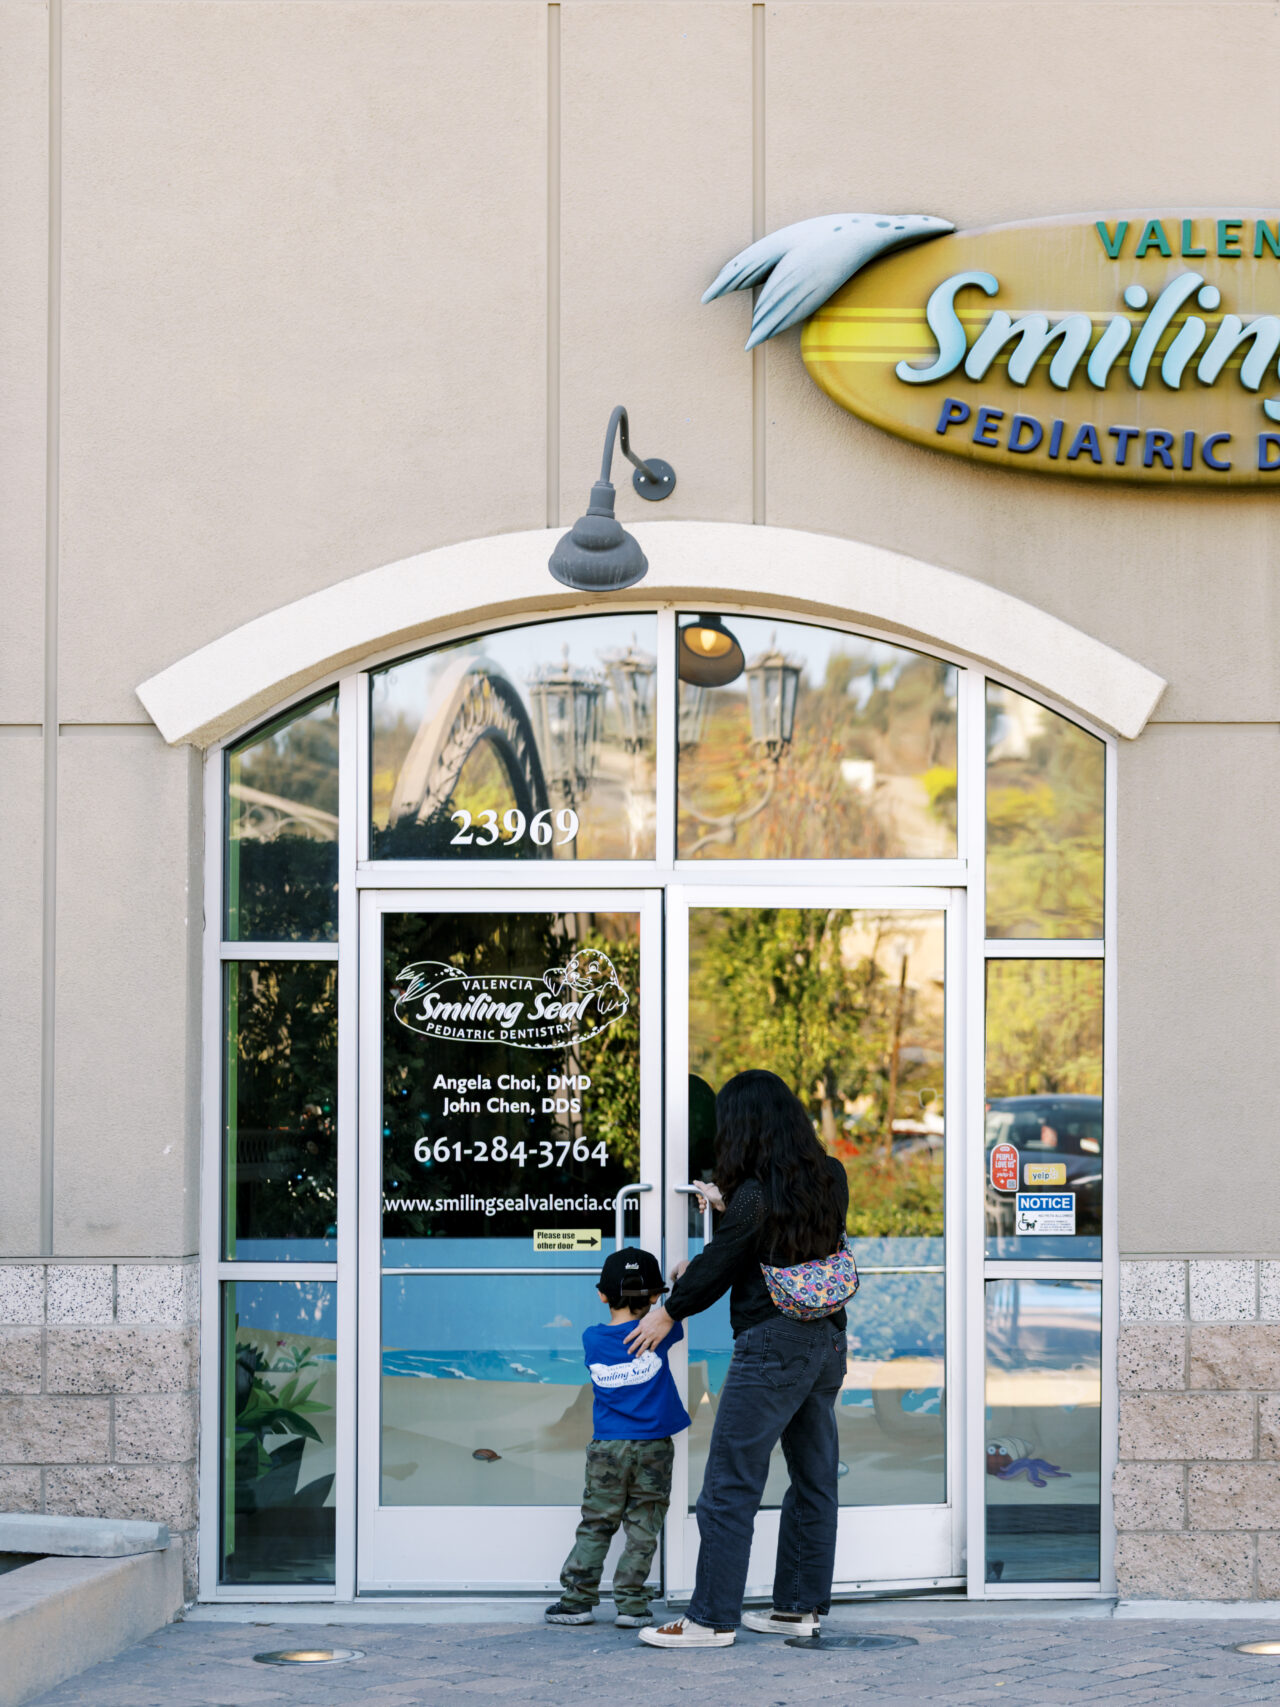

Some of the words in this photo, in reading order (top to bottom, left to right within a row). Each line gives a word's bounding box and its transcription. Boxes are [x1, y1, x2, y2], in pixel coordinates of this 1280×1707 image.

[935, 399, 1233, 472] PEDIATRIC
[450, 808, 579, 846] 23969
[462, 979, 533, 991] VALENCIA
[416, 992, 524, 1028] Smiling
[528, 991, 595, 1023] Seal
[426, 1022, 494, 1040] PEDIATRIC
[500, 1022, 572, 1040] DENTISTRY
[433, 1074, 491, 1094] Angela
[497, 1074, 541, 1093] Choi,
[547, 1075, 591, 1091] DMD
[443, 1097, 481, 1115] John
[486, 1097, 535, 1116] Chen,
[541, 1098, 581, 1114] DDS
[414, 1137, 608, 1167] 661-284-3764
[1032, 1172, 1049, 1180] yelp
[1021, 1198, 1070, 1208] NOTICE
[537, 1242, 556, 1250] other
